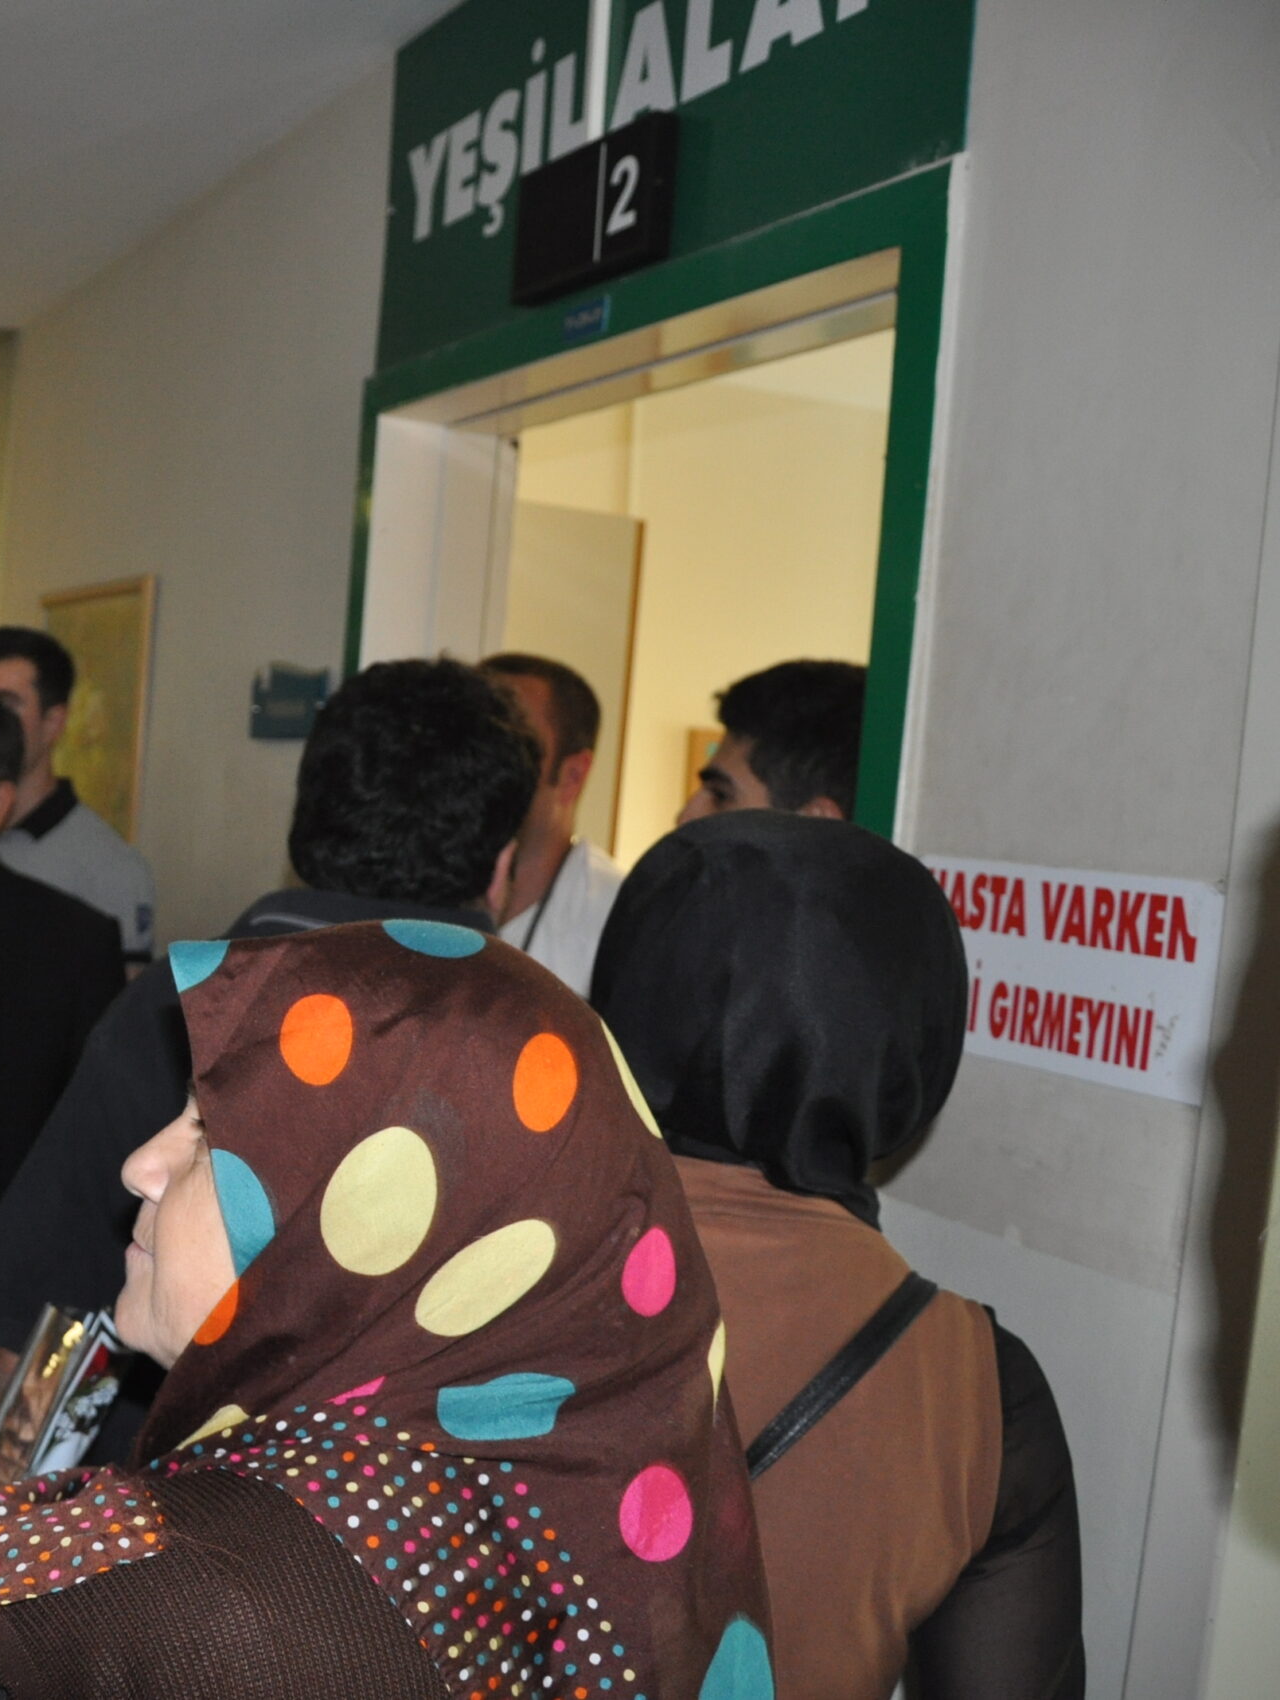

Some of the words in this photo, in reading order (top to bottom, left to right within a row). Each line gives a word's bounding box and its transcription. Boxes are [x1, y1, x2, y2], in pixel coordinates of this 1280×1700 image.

[408, 38, 589, 241] YEŞİL
[610, 0, 869, 131] ALA
[608, 155, 640, 236] 2
[1041, 880, 1198, 964] VARKEN
